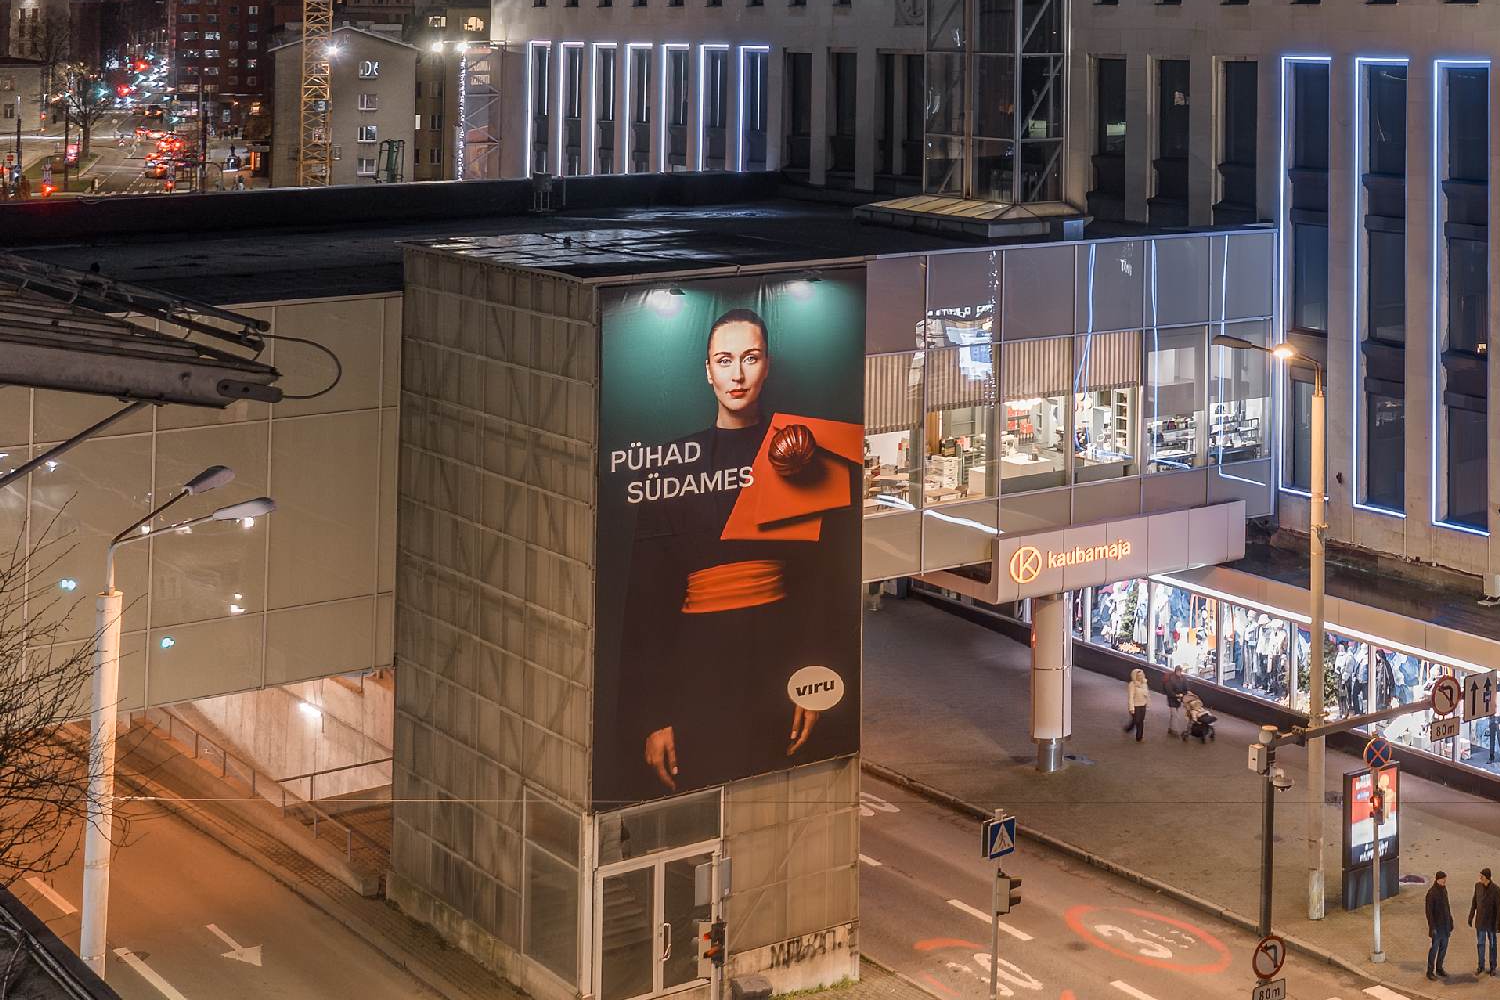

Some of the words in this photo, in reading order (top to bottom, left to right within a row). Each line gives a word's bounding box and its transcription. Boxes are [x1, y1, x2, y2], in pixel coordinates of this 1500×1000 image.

[610, 441, 701, 473] PÜHAD
[627, 465, 755, 504] SÜDAMES
[1048, 539, 1132, 569] kaubamaja
[795, 678, 836, 698] viru
